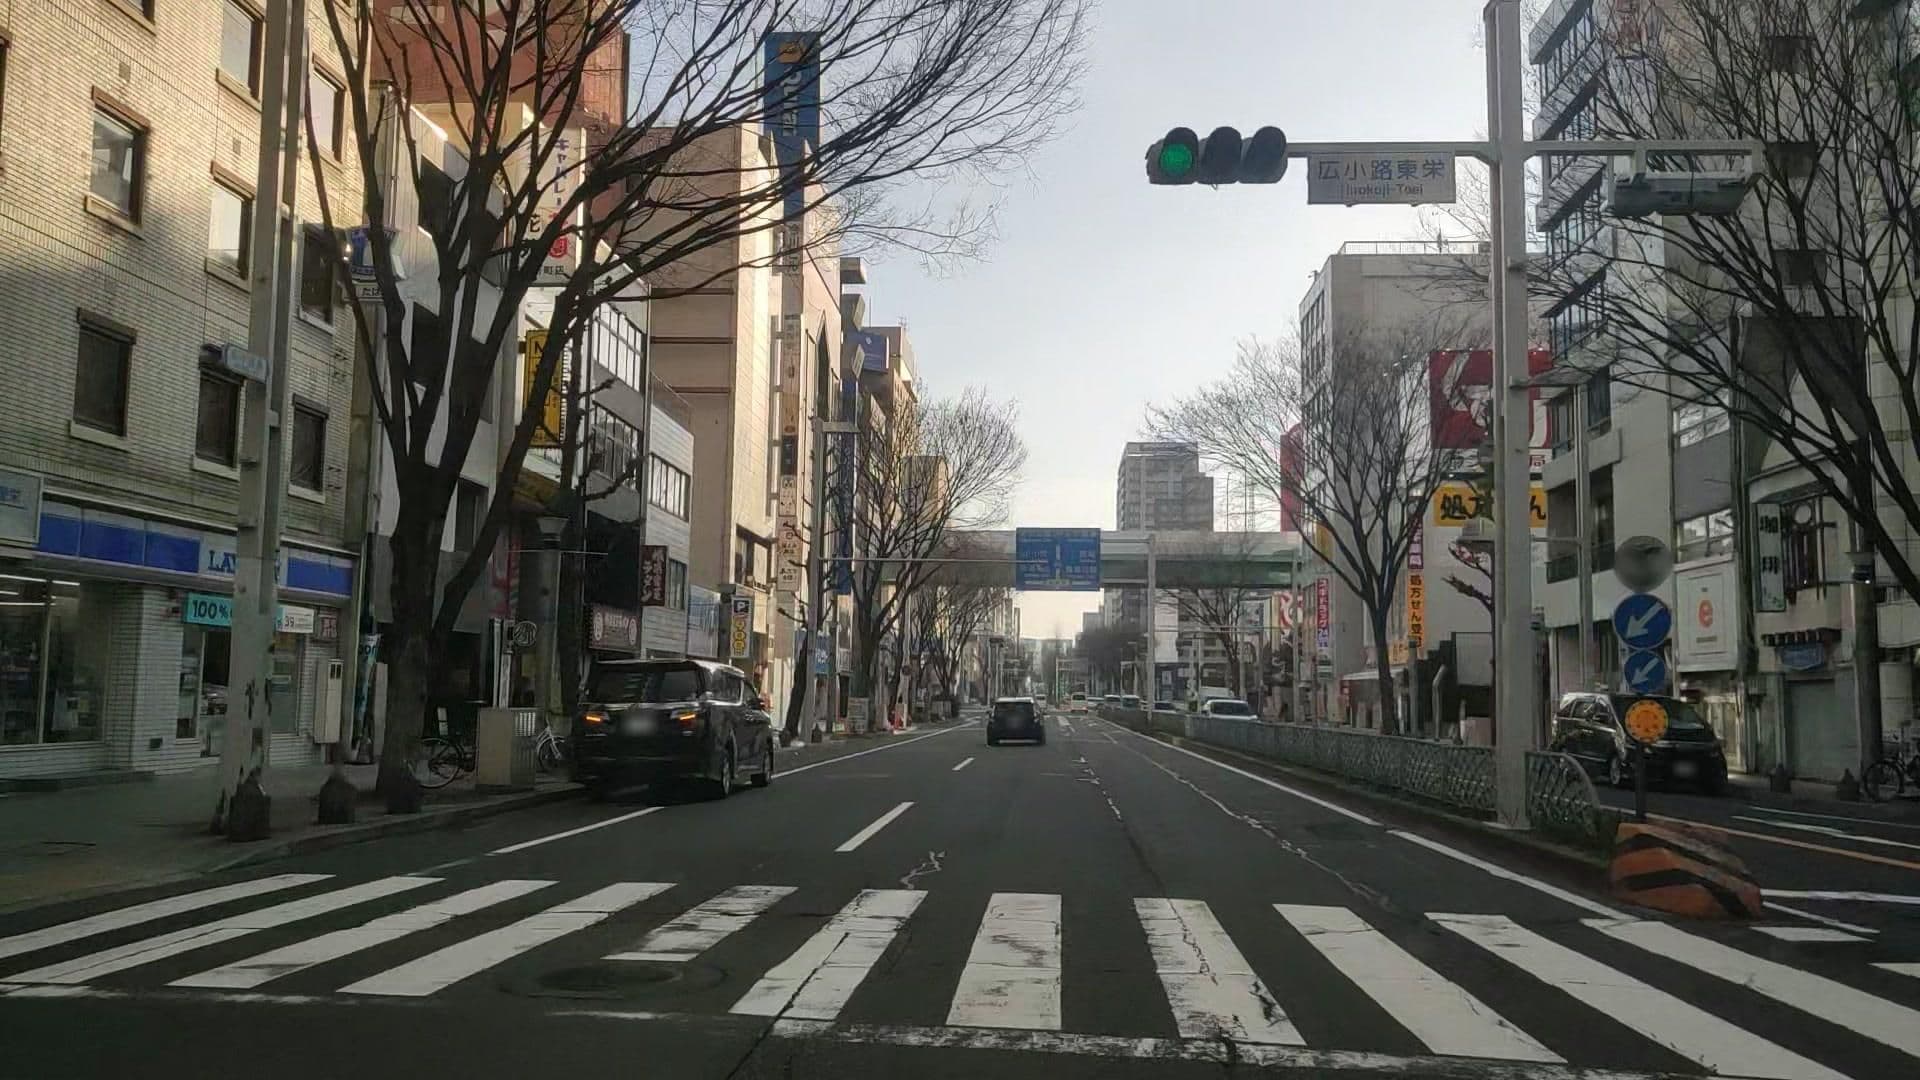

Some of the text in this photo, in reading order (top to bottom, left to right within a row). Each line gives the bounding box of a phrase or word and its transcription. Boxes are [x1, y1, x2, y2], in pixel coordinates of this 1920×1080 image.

[1317, 159, 1446, 181] 広小路東栄
